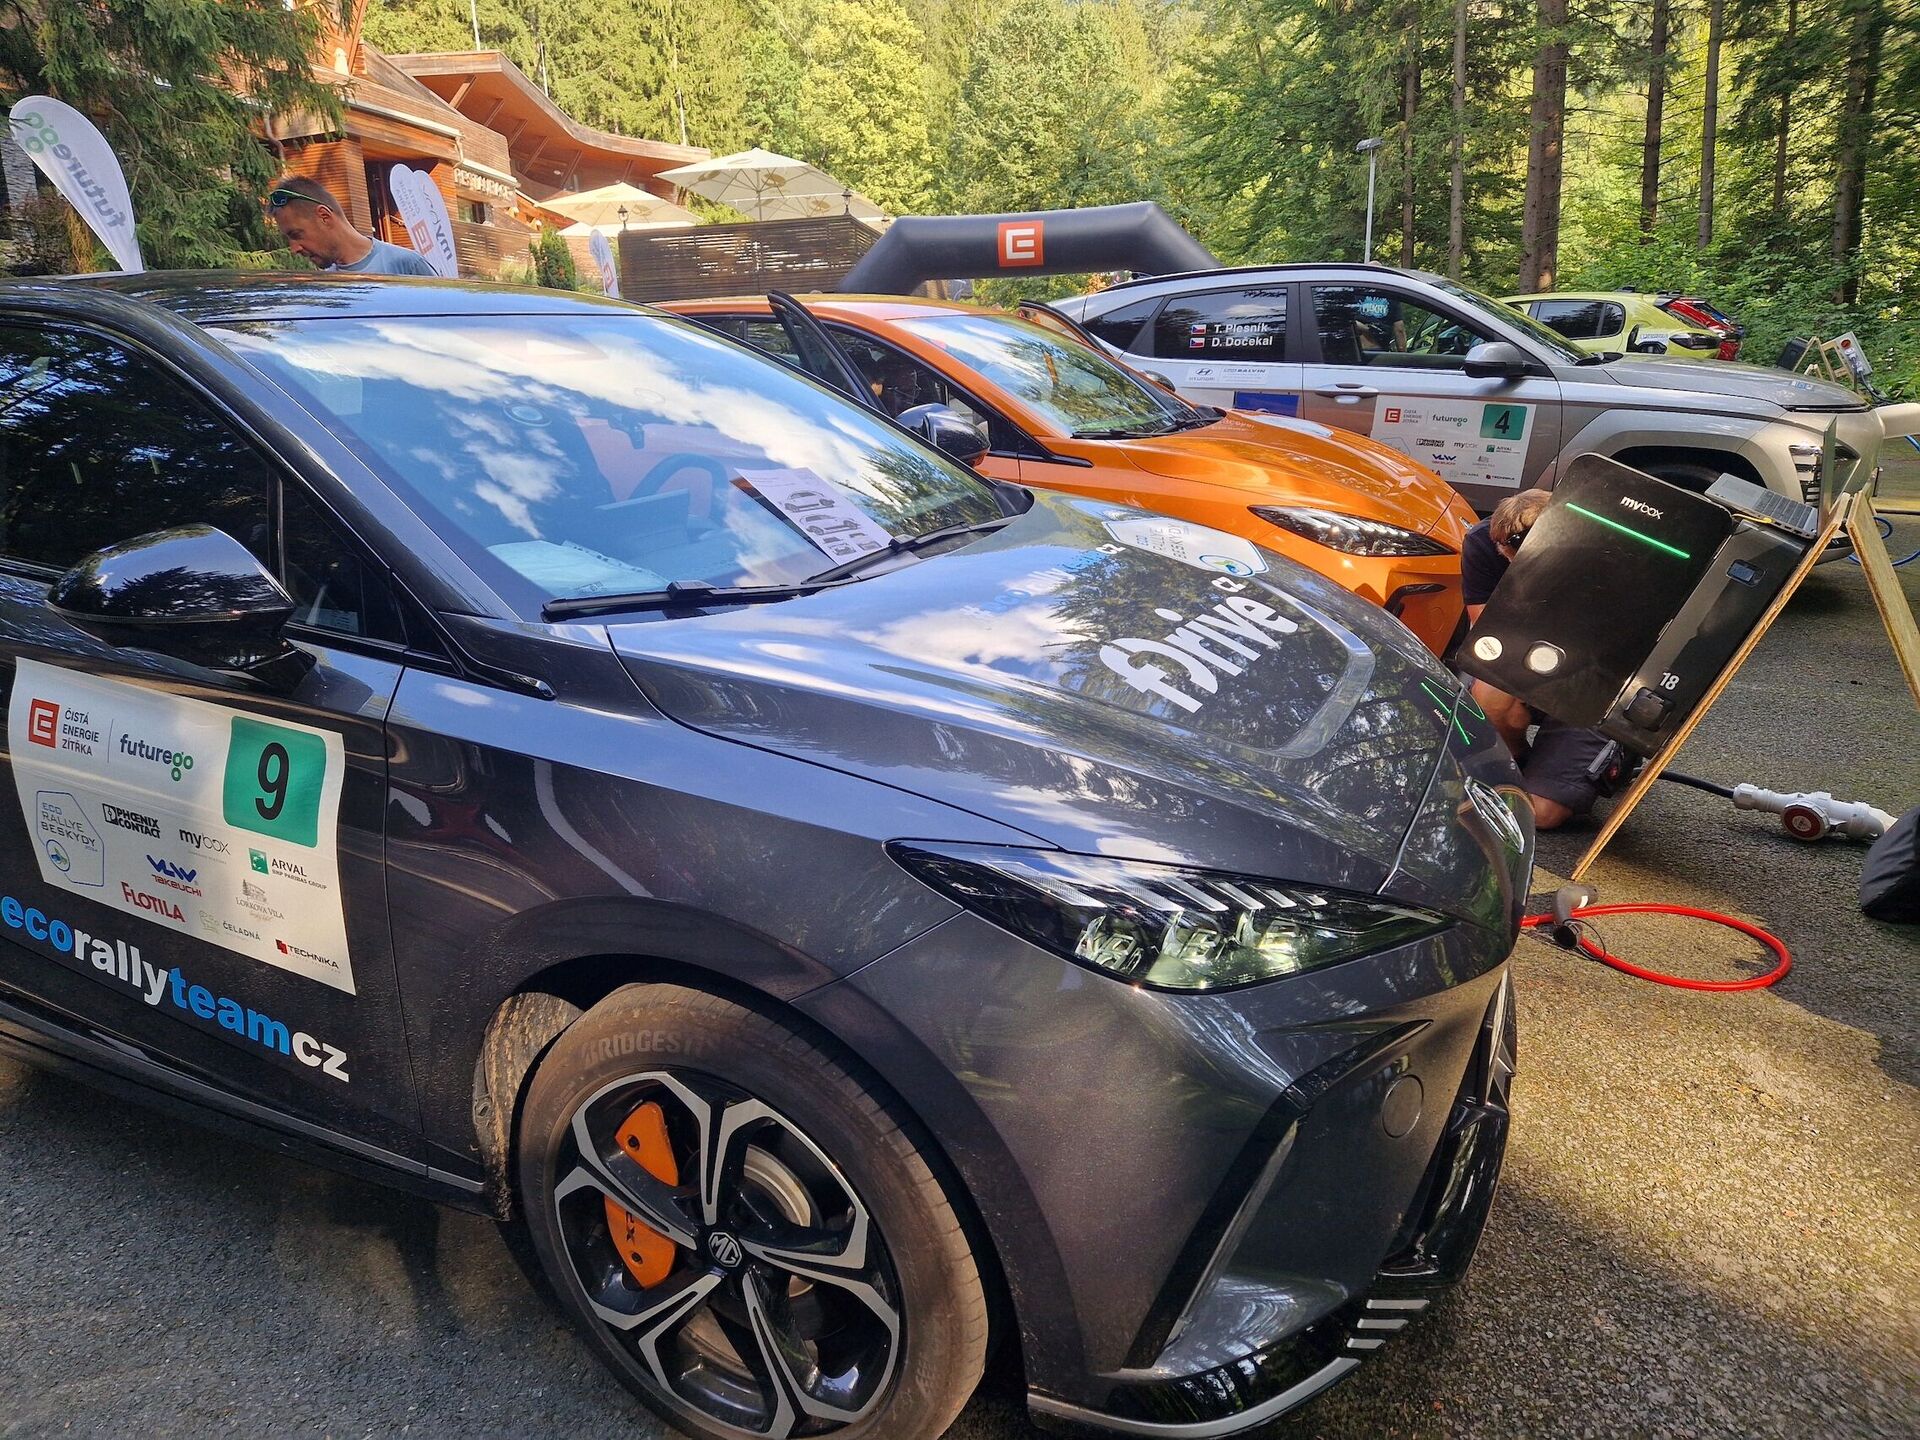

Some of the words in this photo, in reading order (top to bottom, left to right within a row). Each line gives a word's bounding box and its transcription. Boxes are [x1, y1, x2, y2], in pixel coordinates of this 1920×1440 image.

[1211, 337, 1222, 347] D.
[1225, 336, 1273, 347] Dočekal
[1494, 410, 1510, 434] 4
[1620, 496, 1664, 520] mybox
[1659, 671, 1680, 691] 18
[64, 707, 90, 725] ČISTÁ
[62, 723, 100, 743] ENERGIE
[61, 738, 93, 757] ZÍTŘKA
[119, 733, 194, 782] futurego
[255, 742, 290, 821] 9
[42, 802, 63, 815] ECO
[42, 811, 84, 833] RALLYE
[118, 820, 161, 839] CONTACT
[40, 821, 96, 847] BESKYDY
[179, 828, 231, 856] mybox
[271, 858, 307, 877] ARVAL
[121, 881, 186, 923] FLOTILA
[287, 944, 340, 969] TECHNIKA
[710, 1234, 740, 1264] MG
